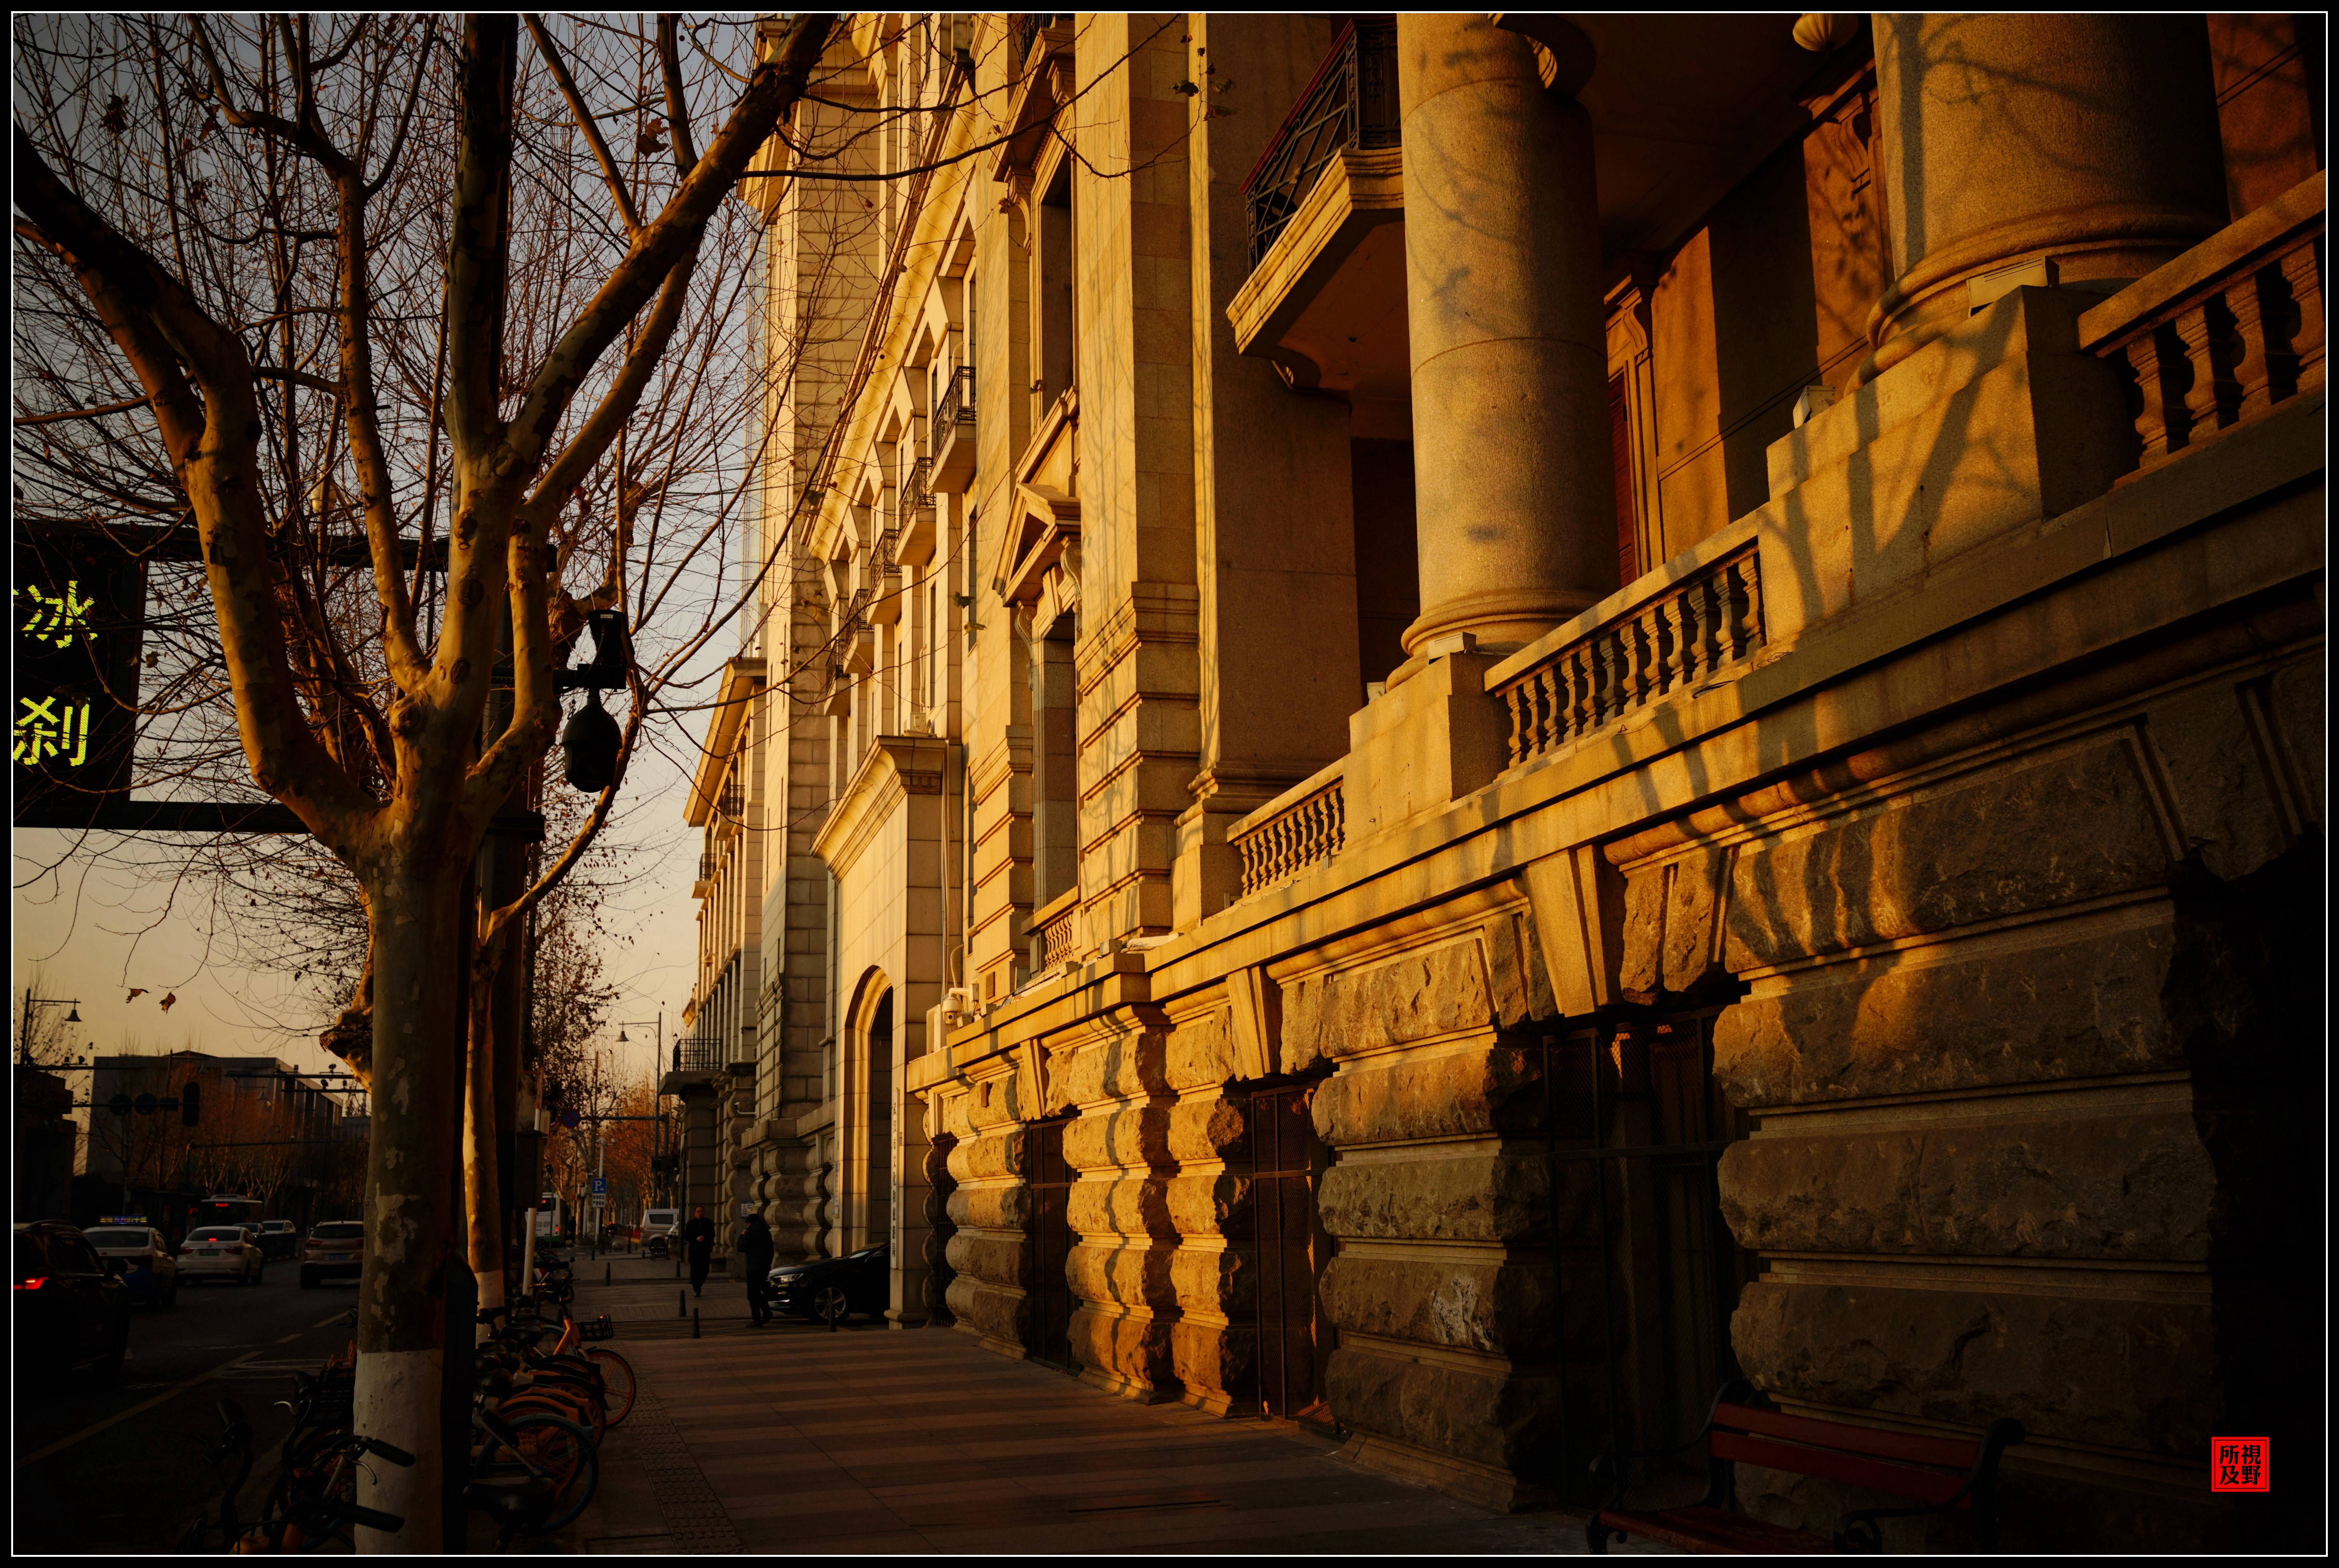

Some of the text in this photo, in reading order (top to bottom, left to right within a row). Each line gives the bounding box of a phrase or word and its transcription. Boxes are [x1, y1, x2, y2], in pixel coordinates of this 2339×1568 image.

[13, 580, 98, 648] 冰
[13, 696, 90, 766] 刹
[594, 1181, 602, 1191] P
